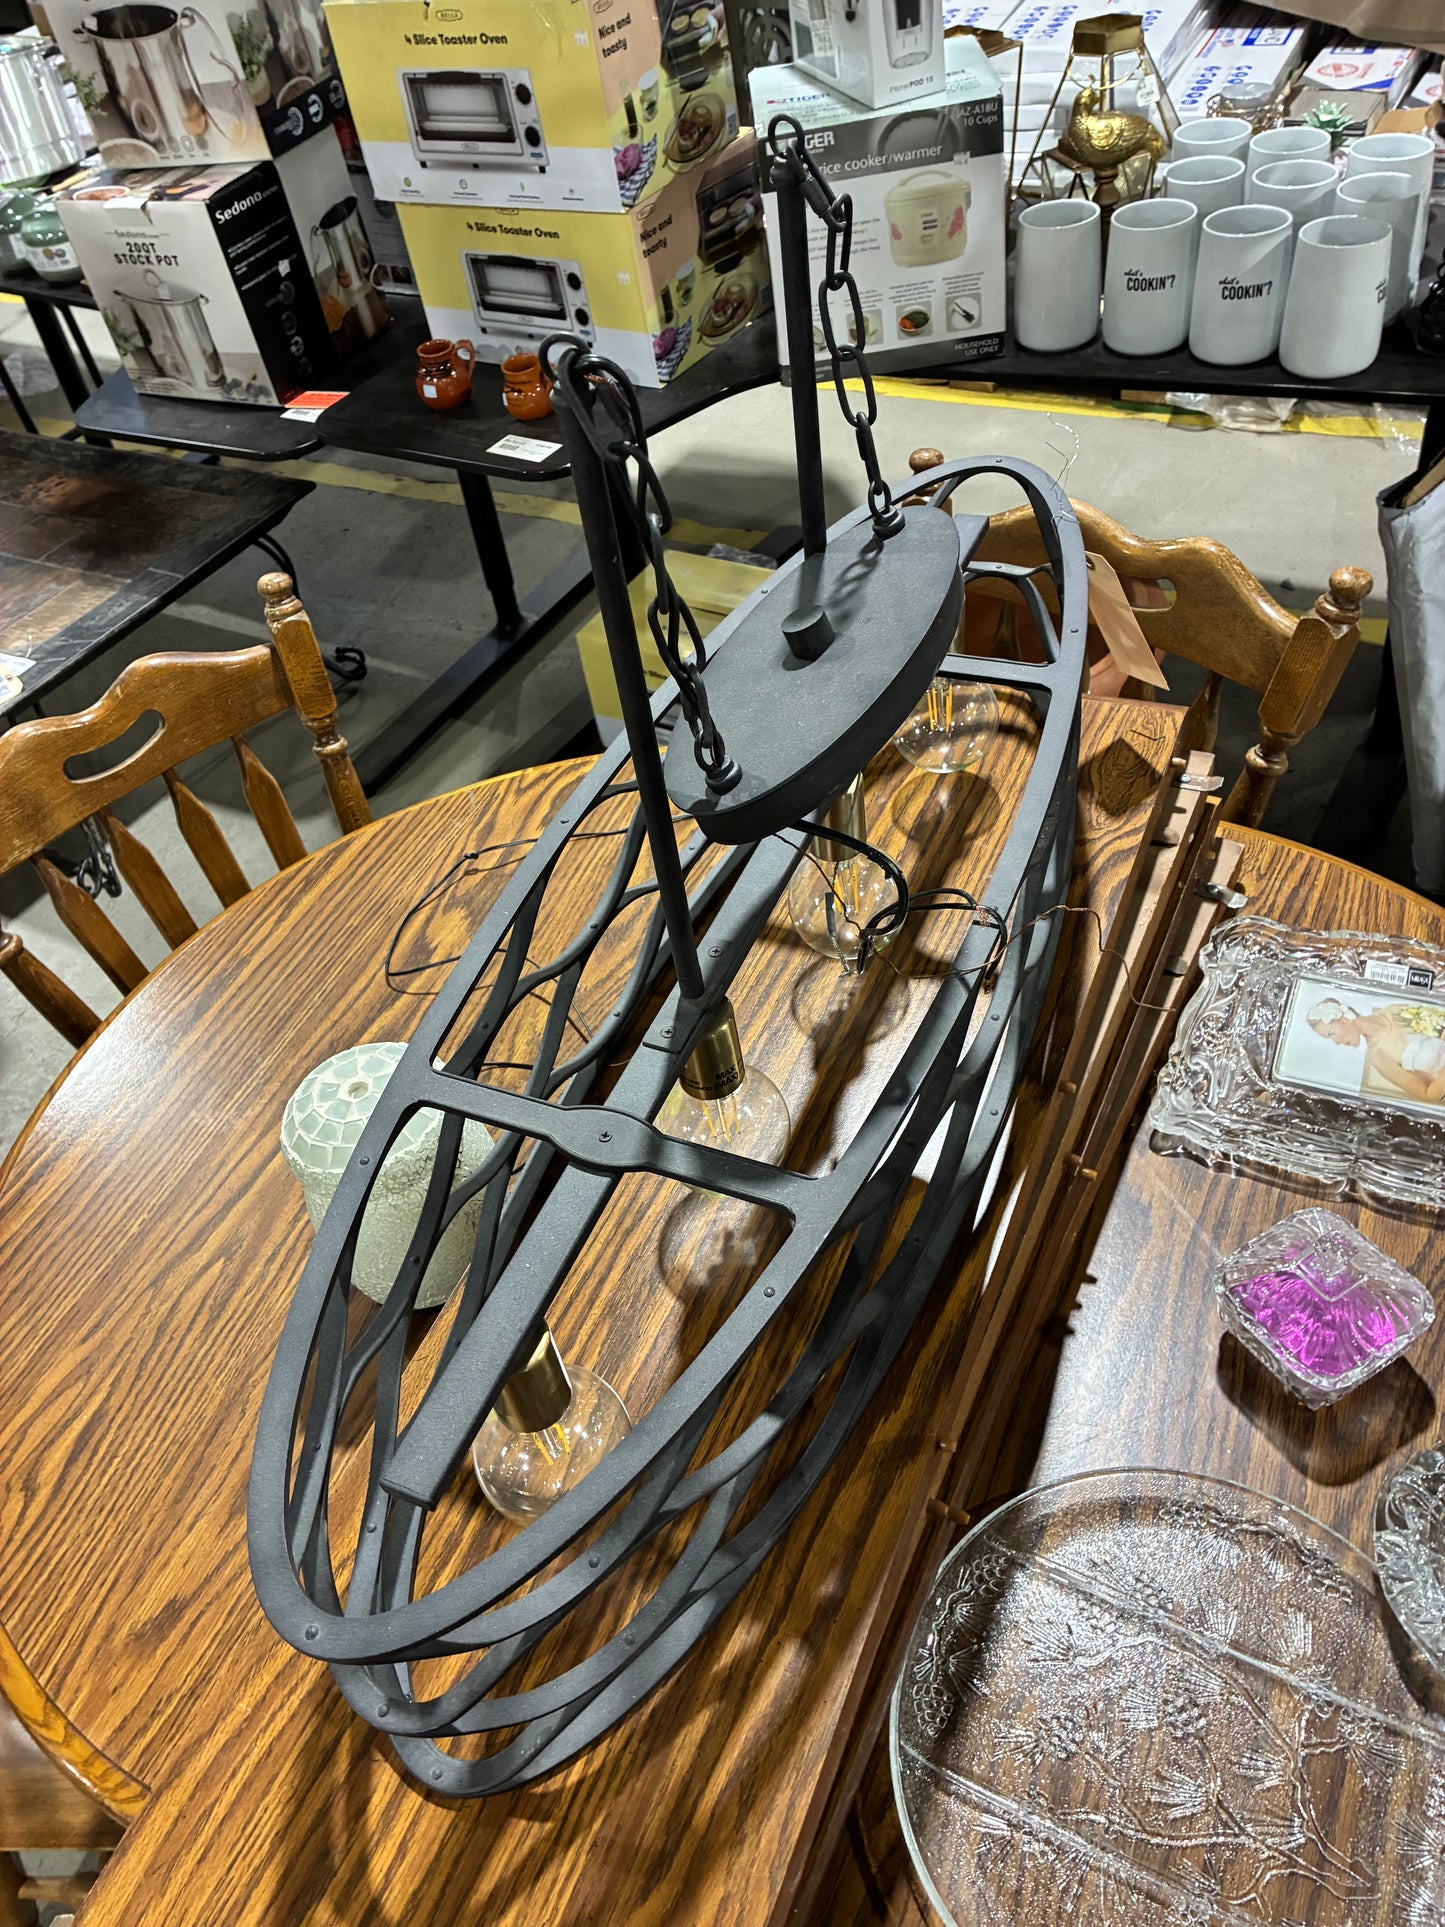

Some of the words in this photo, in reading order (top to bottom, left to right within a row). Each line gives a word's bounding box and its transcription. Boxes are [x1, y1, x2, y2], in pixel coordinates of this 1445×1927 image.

[598, 24, 616, 39] Nice
[616, 12, 631, 30] and
[404, 34, 412, 45] 4
[413, 33, 438, 45] Slice
[438, 33, 477, 46] Toaster
[479, 32, 508, 45] Oven
[602, 38, 628, 58] toasty
[963, 117, 974, 127] 10
[975, 114, 998, 127] Cups
[818, 162, 841, 175] rice
[844, 145, 943, 171] cooker/warmer
[474, 222, 497, 232] Slice
[498, 224, 533, 236] Toaster
[534, 227, 560, 239] Oven
[640, 227, 657, 244] Nice
[658, 213, 673, 231] and
[643, 237, 667, 258] toasty
[114, 253, 153, 266] STOCK
[155, 255, 179, 267] POT
[1126, 274, 1176, 291] COOKIN'?
[1221, 281, 1273, 300] COOKIN'?
[954, 337, 999, 351] HOUSEHOLD
[965, 348, 978, 356] USE
[979, 345, 999, 354] ONLY
